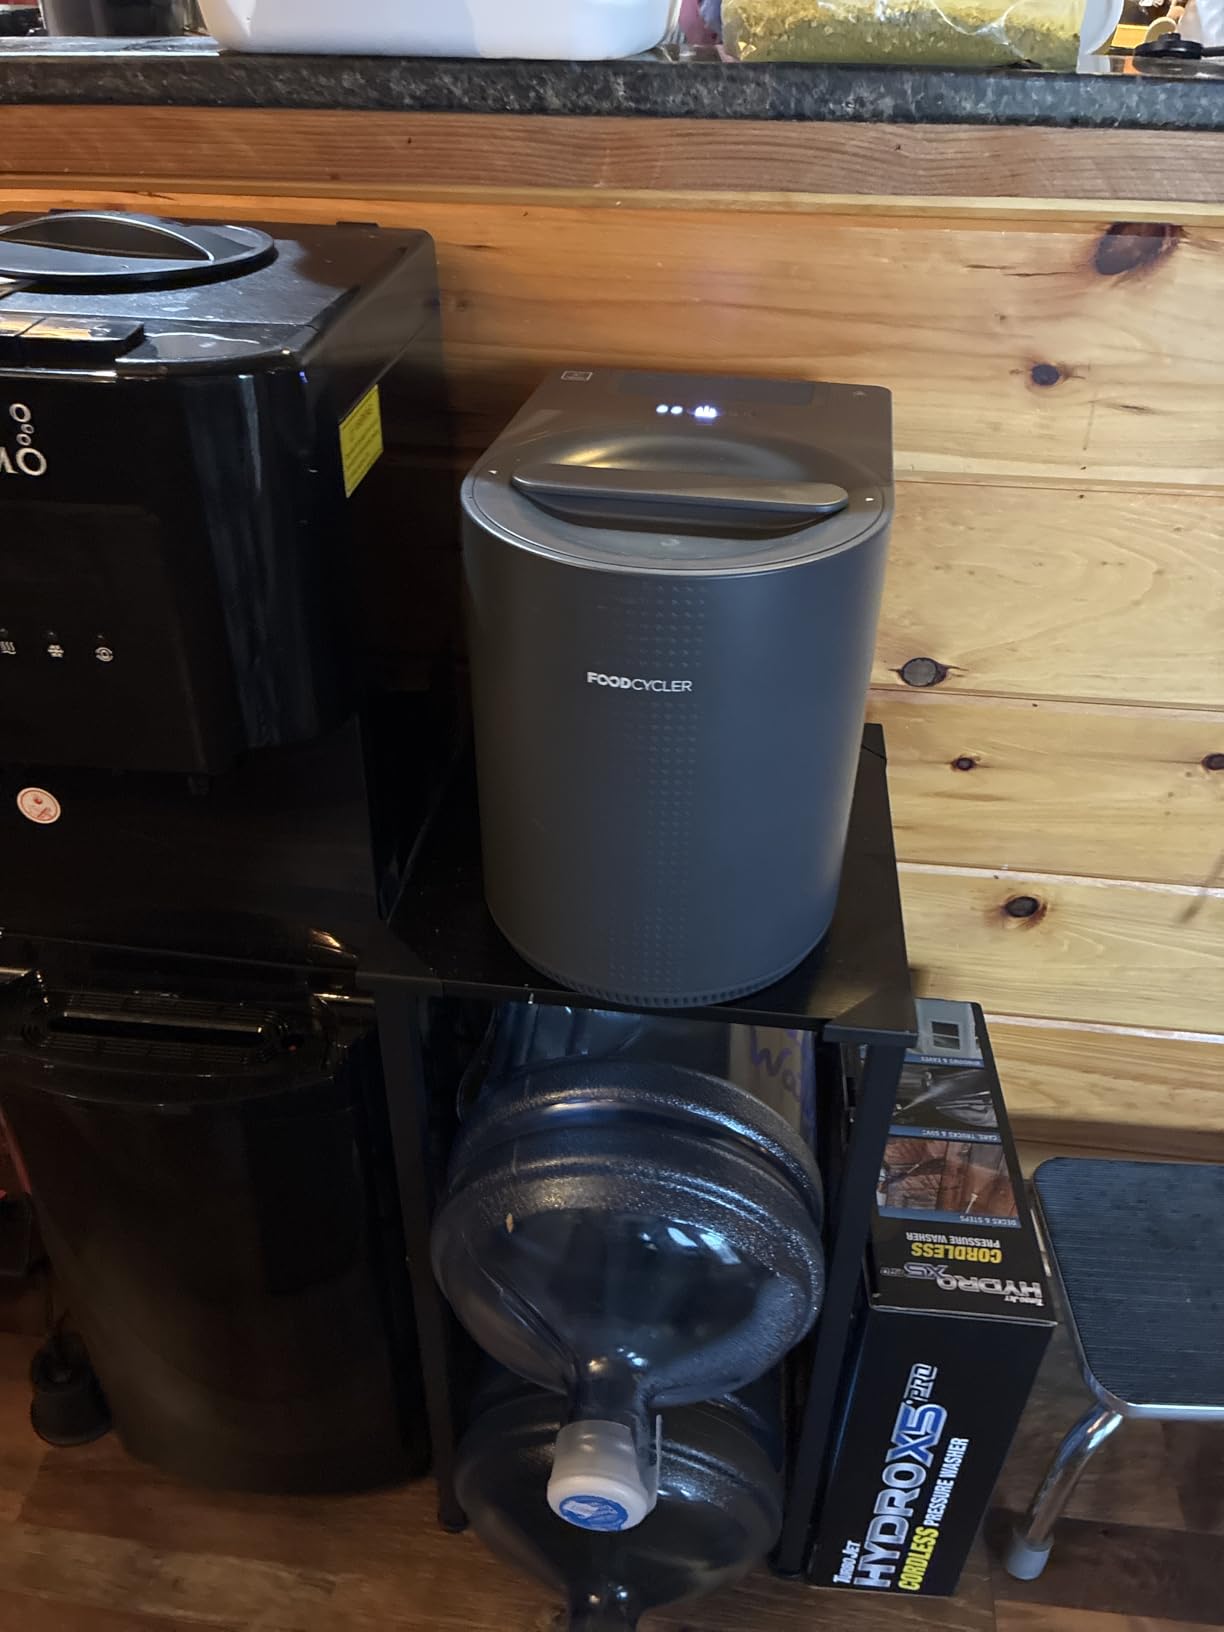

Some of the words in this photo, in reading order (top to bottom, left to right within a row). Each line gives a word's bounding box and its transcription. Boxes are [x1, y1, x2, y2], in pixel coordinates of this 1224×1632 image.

[586, 671, 693, 692] FOODCYCLER
[959, 1215, 984, 1224] STEPS
[991, 1218, 1018, 1227] DECKS
[906, 1231, 948, 1243] WASHER
[949, 1235, 1001, 1248] PRESSURE
[911, 1242, 1003, 1264] CORDLESS
[898, 1526, 940, 1591] CORDLESS
[923, 1479, 954, 1528] PRESSURE
[939, 1437, 970, 1479] WASHER
